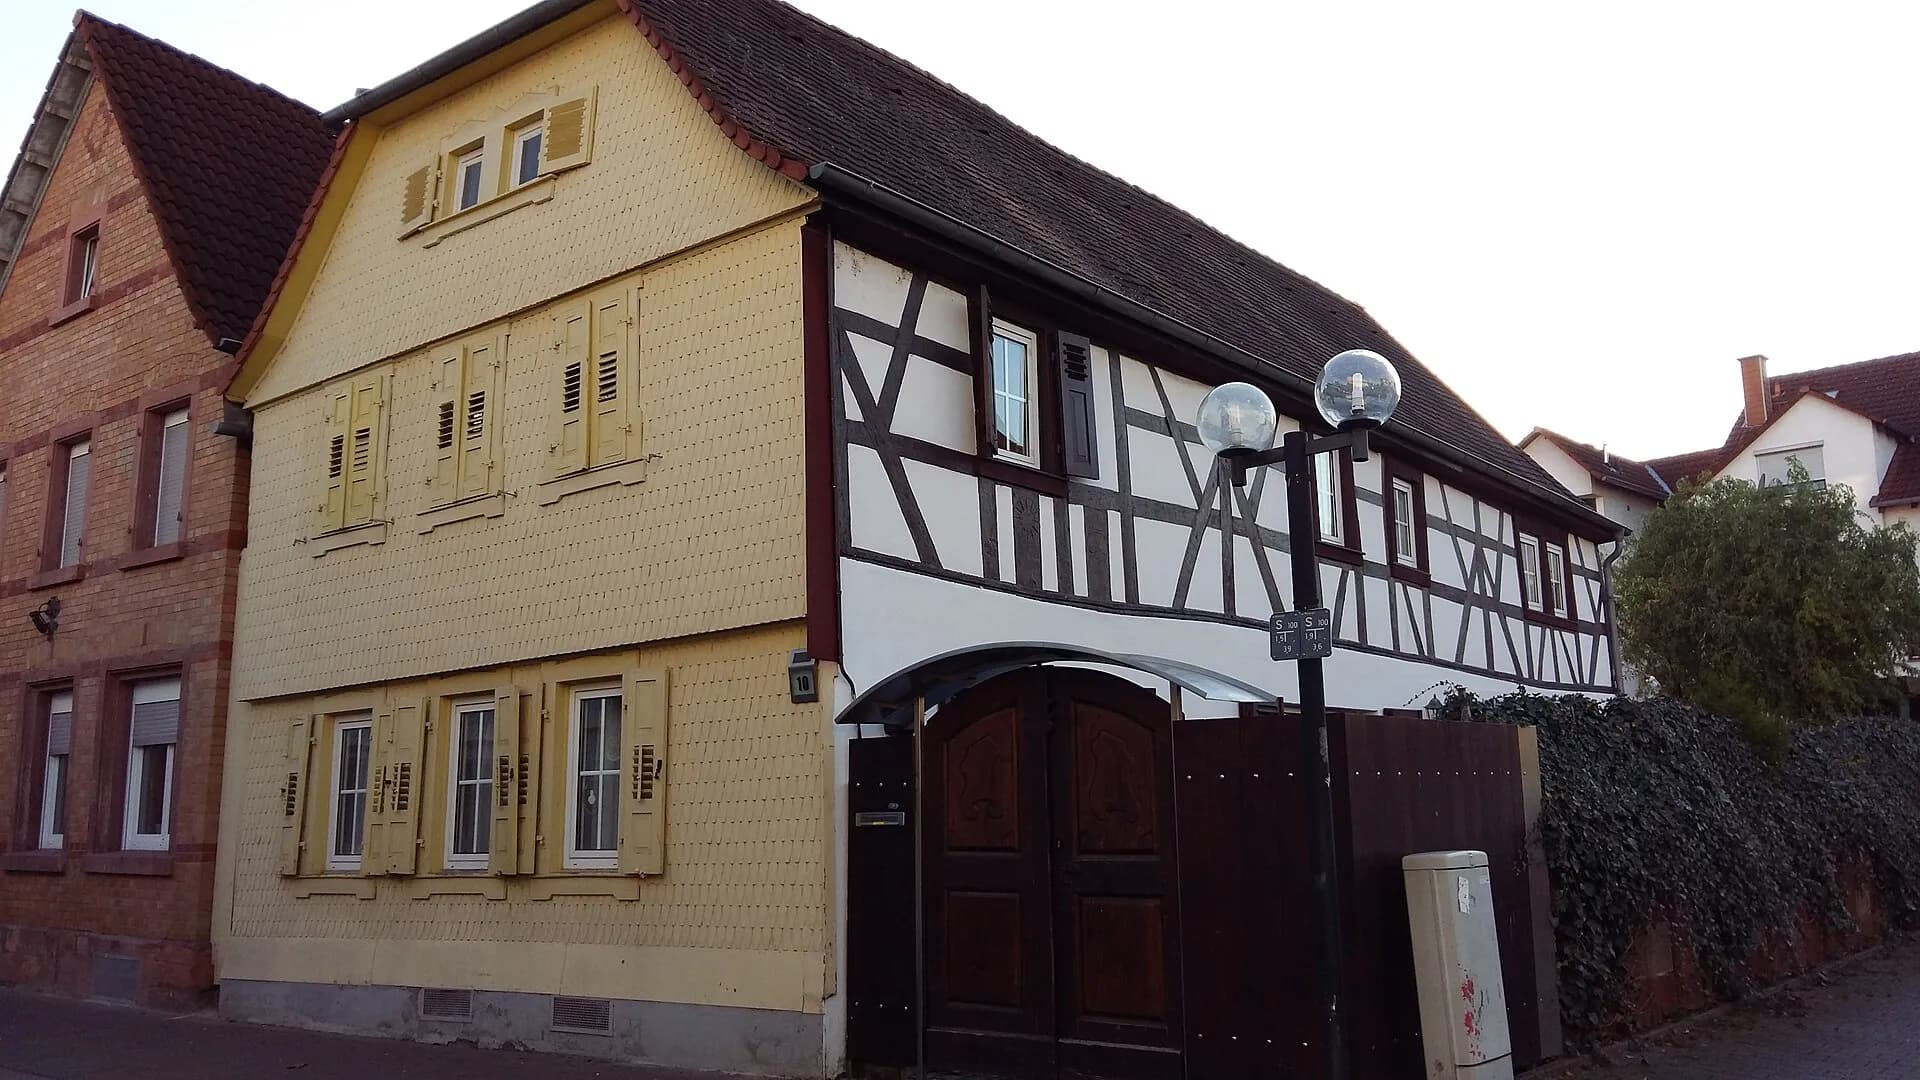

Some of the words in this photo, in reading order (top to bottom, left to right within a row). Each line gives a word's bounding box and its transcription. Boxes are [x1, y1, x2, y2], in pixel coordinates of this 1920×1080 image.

[1275, 620, 1283, 630] S
[1305, 617, 1313, 627] S
[796, 676, 809, 691] 10
